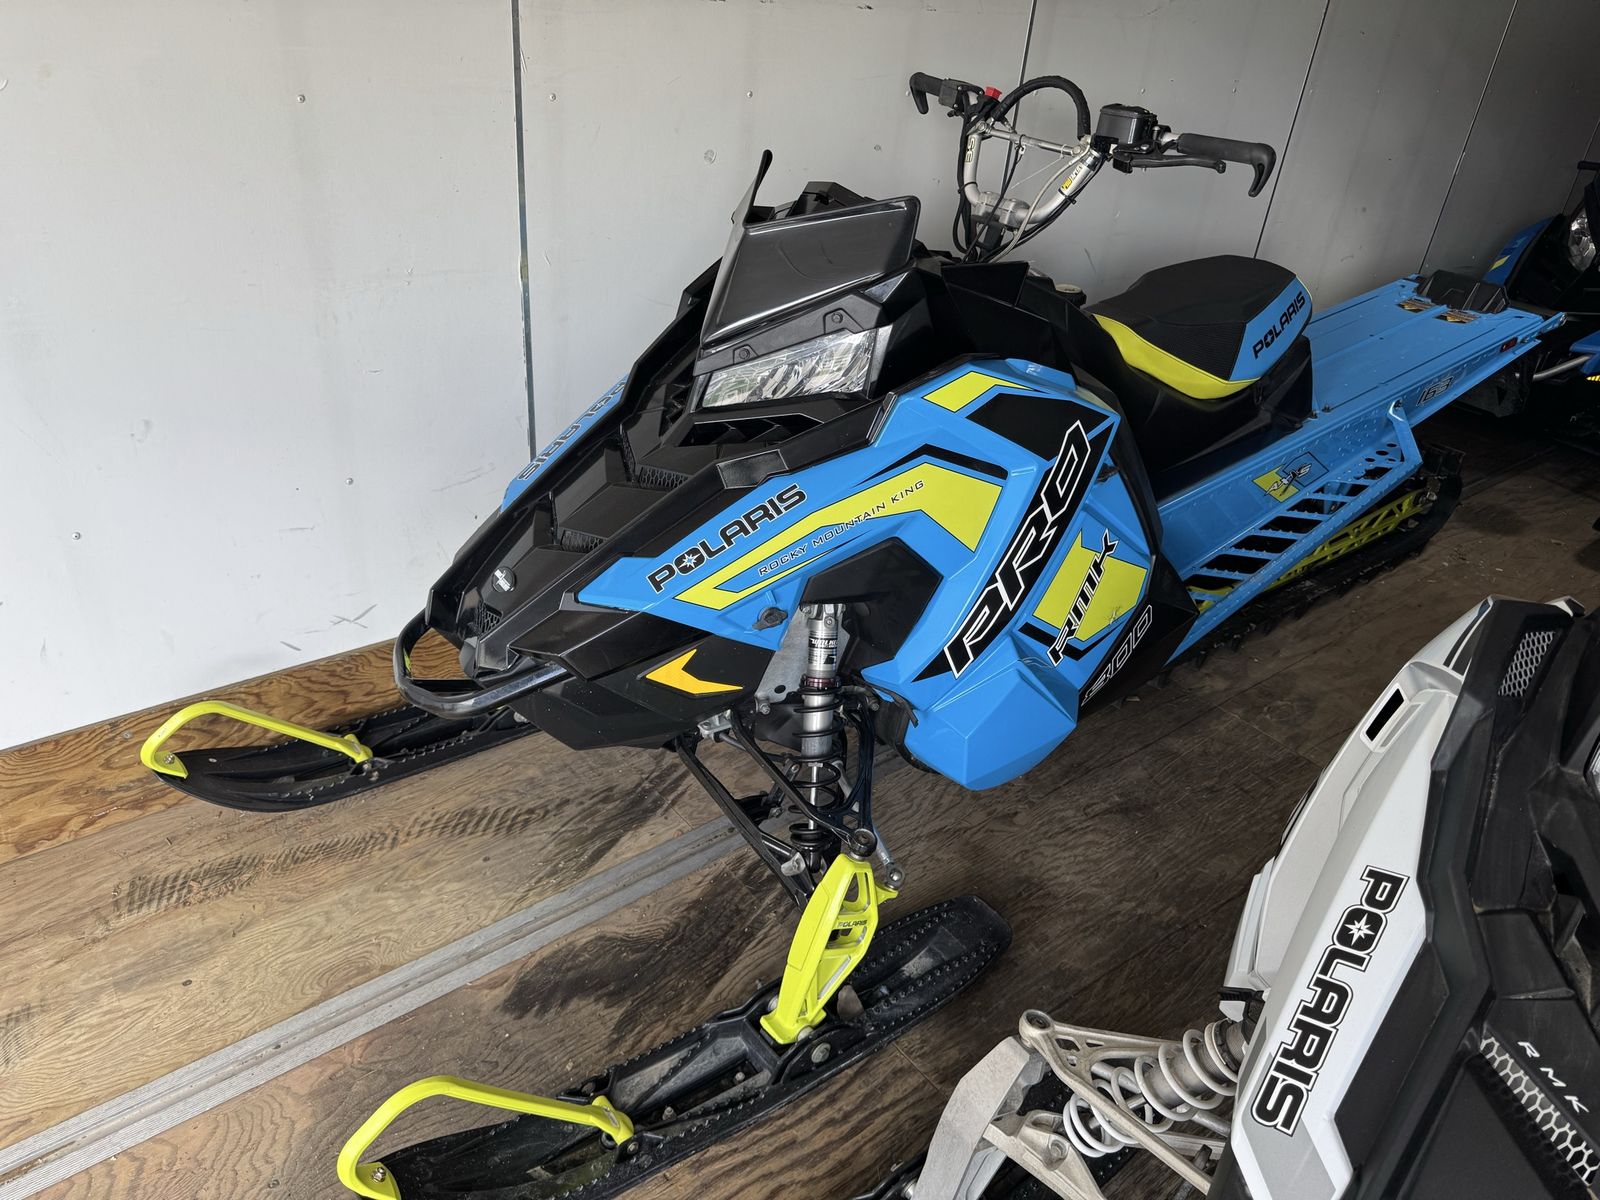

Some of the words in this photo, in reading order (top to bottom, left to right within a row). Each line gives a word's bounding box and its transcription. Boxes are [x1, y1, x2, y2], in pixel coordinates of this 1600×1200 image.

[1252, 290, 1306, 360] POLARIS
[647, 483, 807, 593] POLARIS
[759, 543, 808, 576] ROCKY
[812, 502, 886, 548] MOUNTAIN
[891, 480, 924, 505] KING
[943, 419, 1092, 680] PRO
[1046, 528, 1119, 667] RMK
[1080, 604, 1153, 707] 800
[838, 919, 868, 928] POLARIS
[1250, 864, 1410, 1137] POLARIS
